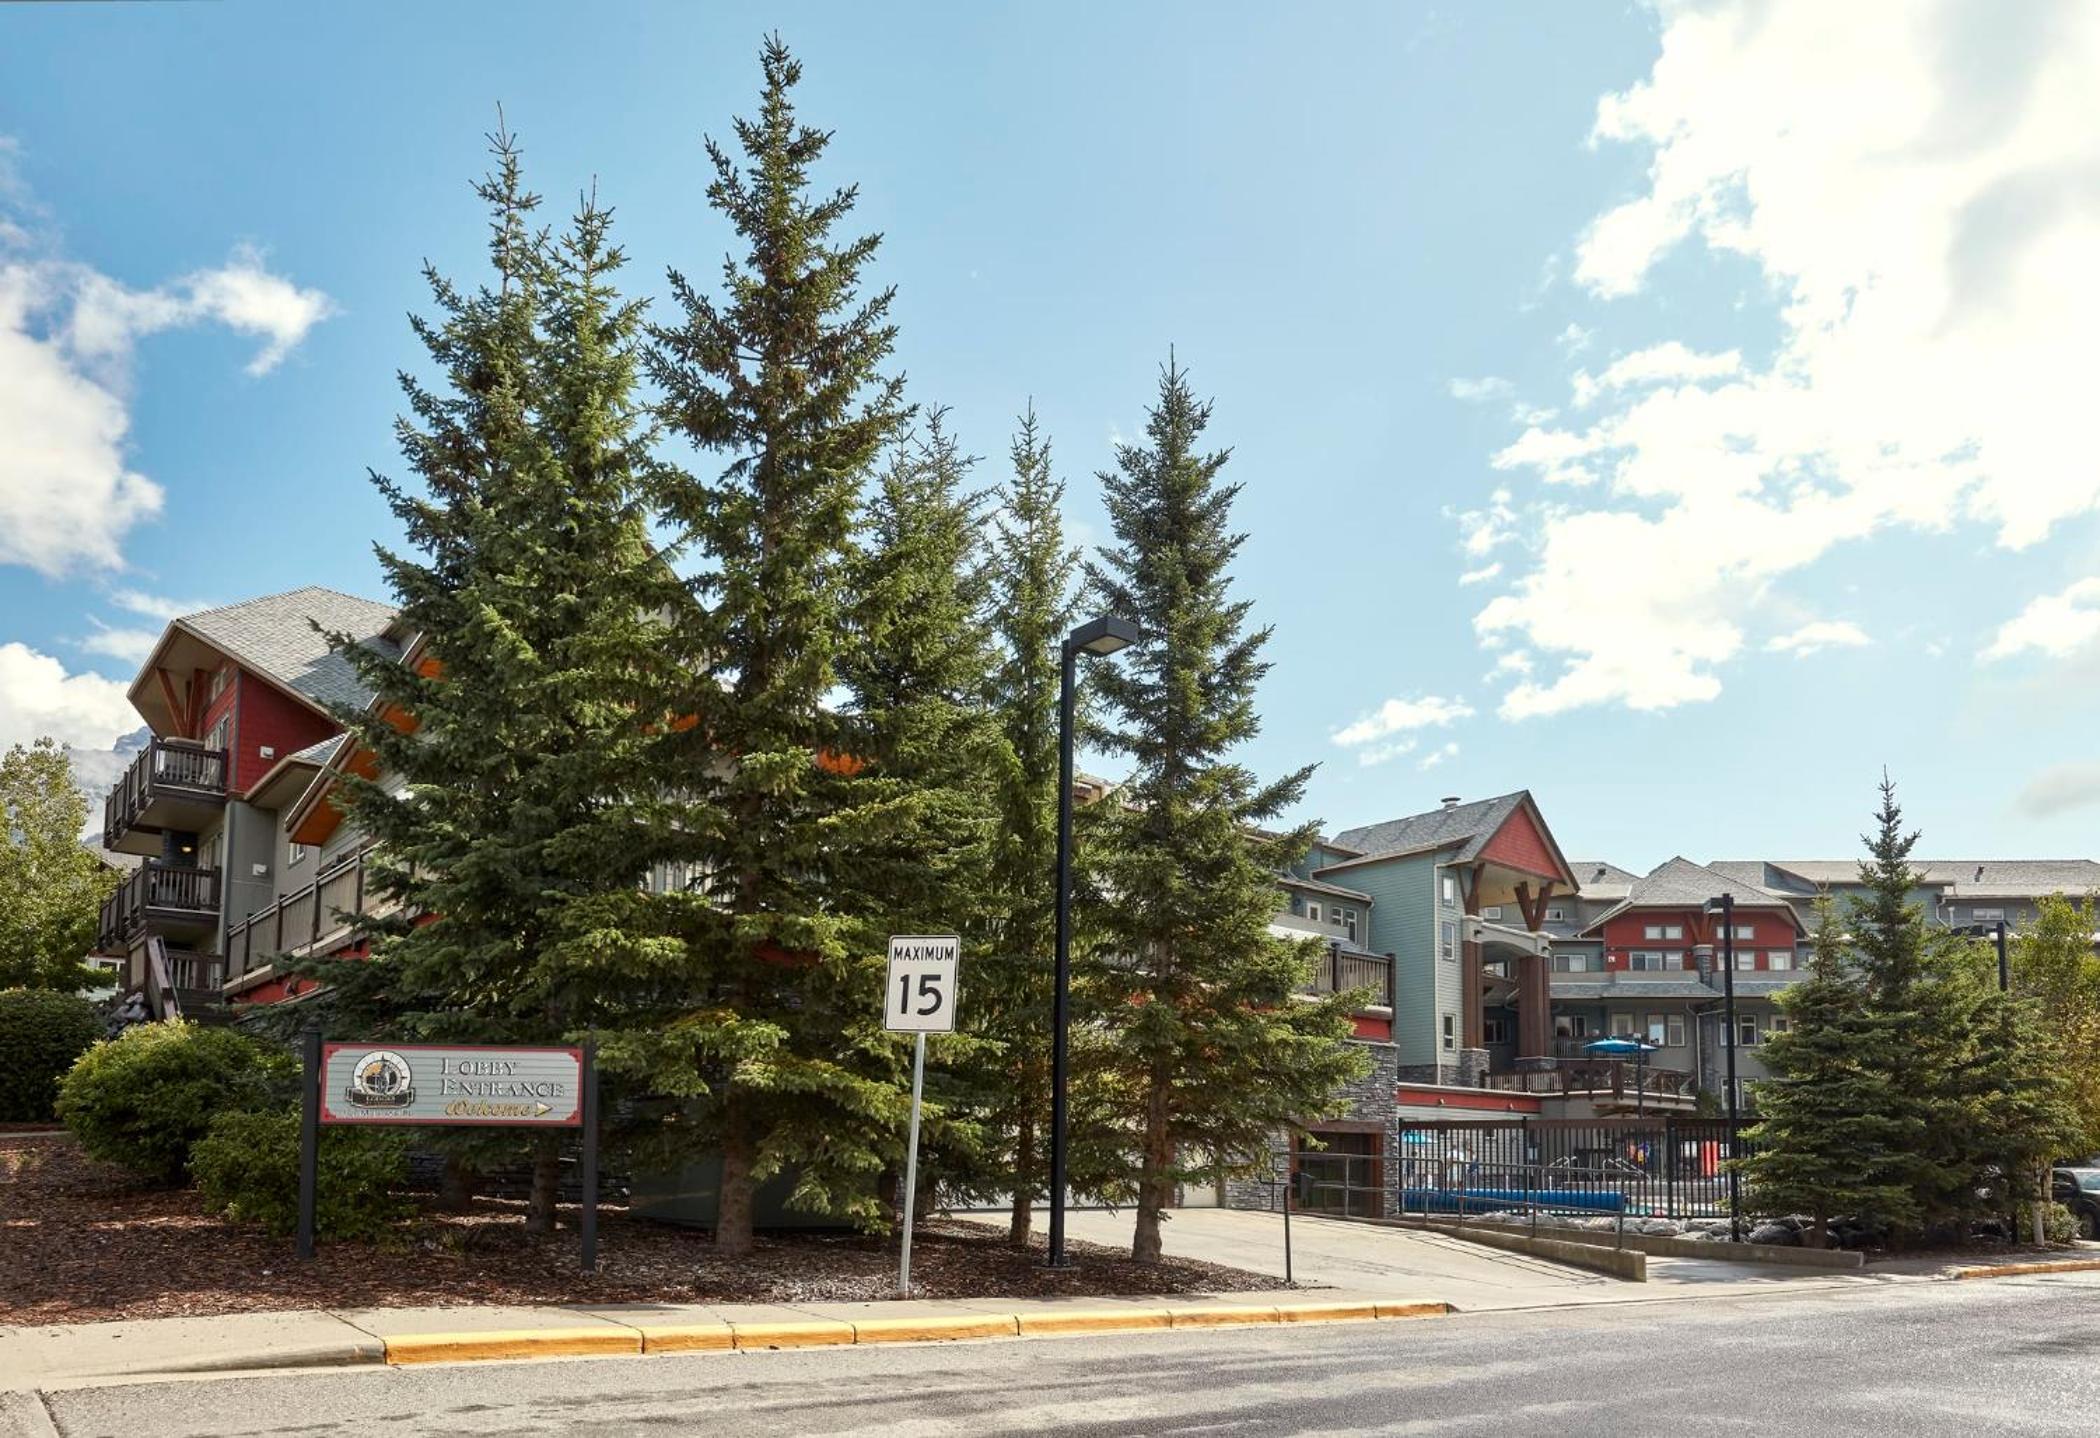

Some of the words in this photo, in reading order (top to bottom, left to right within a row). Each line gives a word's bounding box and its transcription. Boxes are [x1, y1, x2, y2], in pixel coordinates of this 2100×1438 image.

[893, 947, 955, 960] MAXIMUM
[899, 974, 943, 1015] 15
[440, 1057, 518, 1076] LOBBY
[440, 1078, 565, 1097] ENTRANCE
[445, 1099, 530, 1117] Welcome
